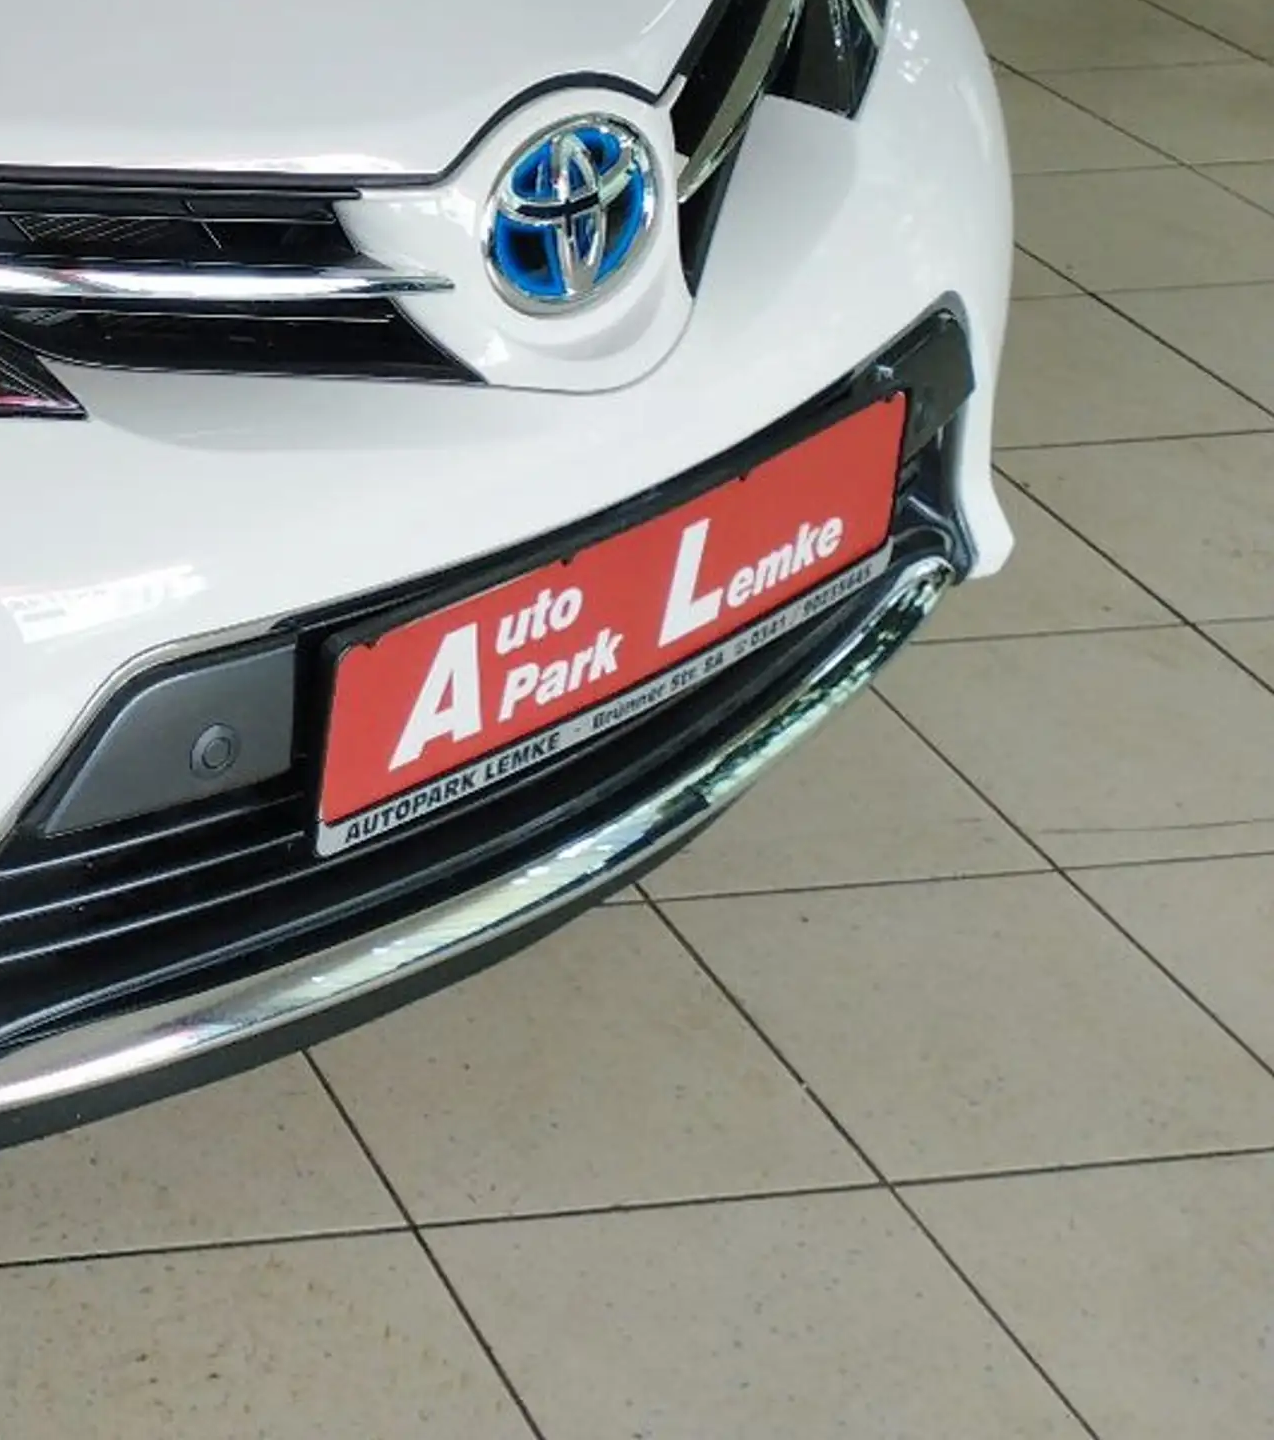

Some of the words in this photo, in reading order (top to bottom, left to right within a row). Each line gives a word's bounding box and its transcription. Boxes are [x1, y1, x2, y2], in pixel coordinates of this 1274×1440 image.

[658, 514, 844, 650] Lemke
[497, 631, 622, 722] Park
[345, 770, 479, 844] AUTOPARK
[482, 732, 561, 780] LEMKE
